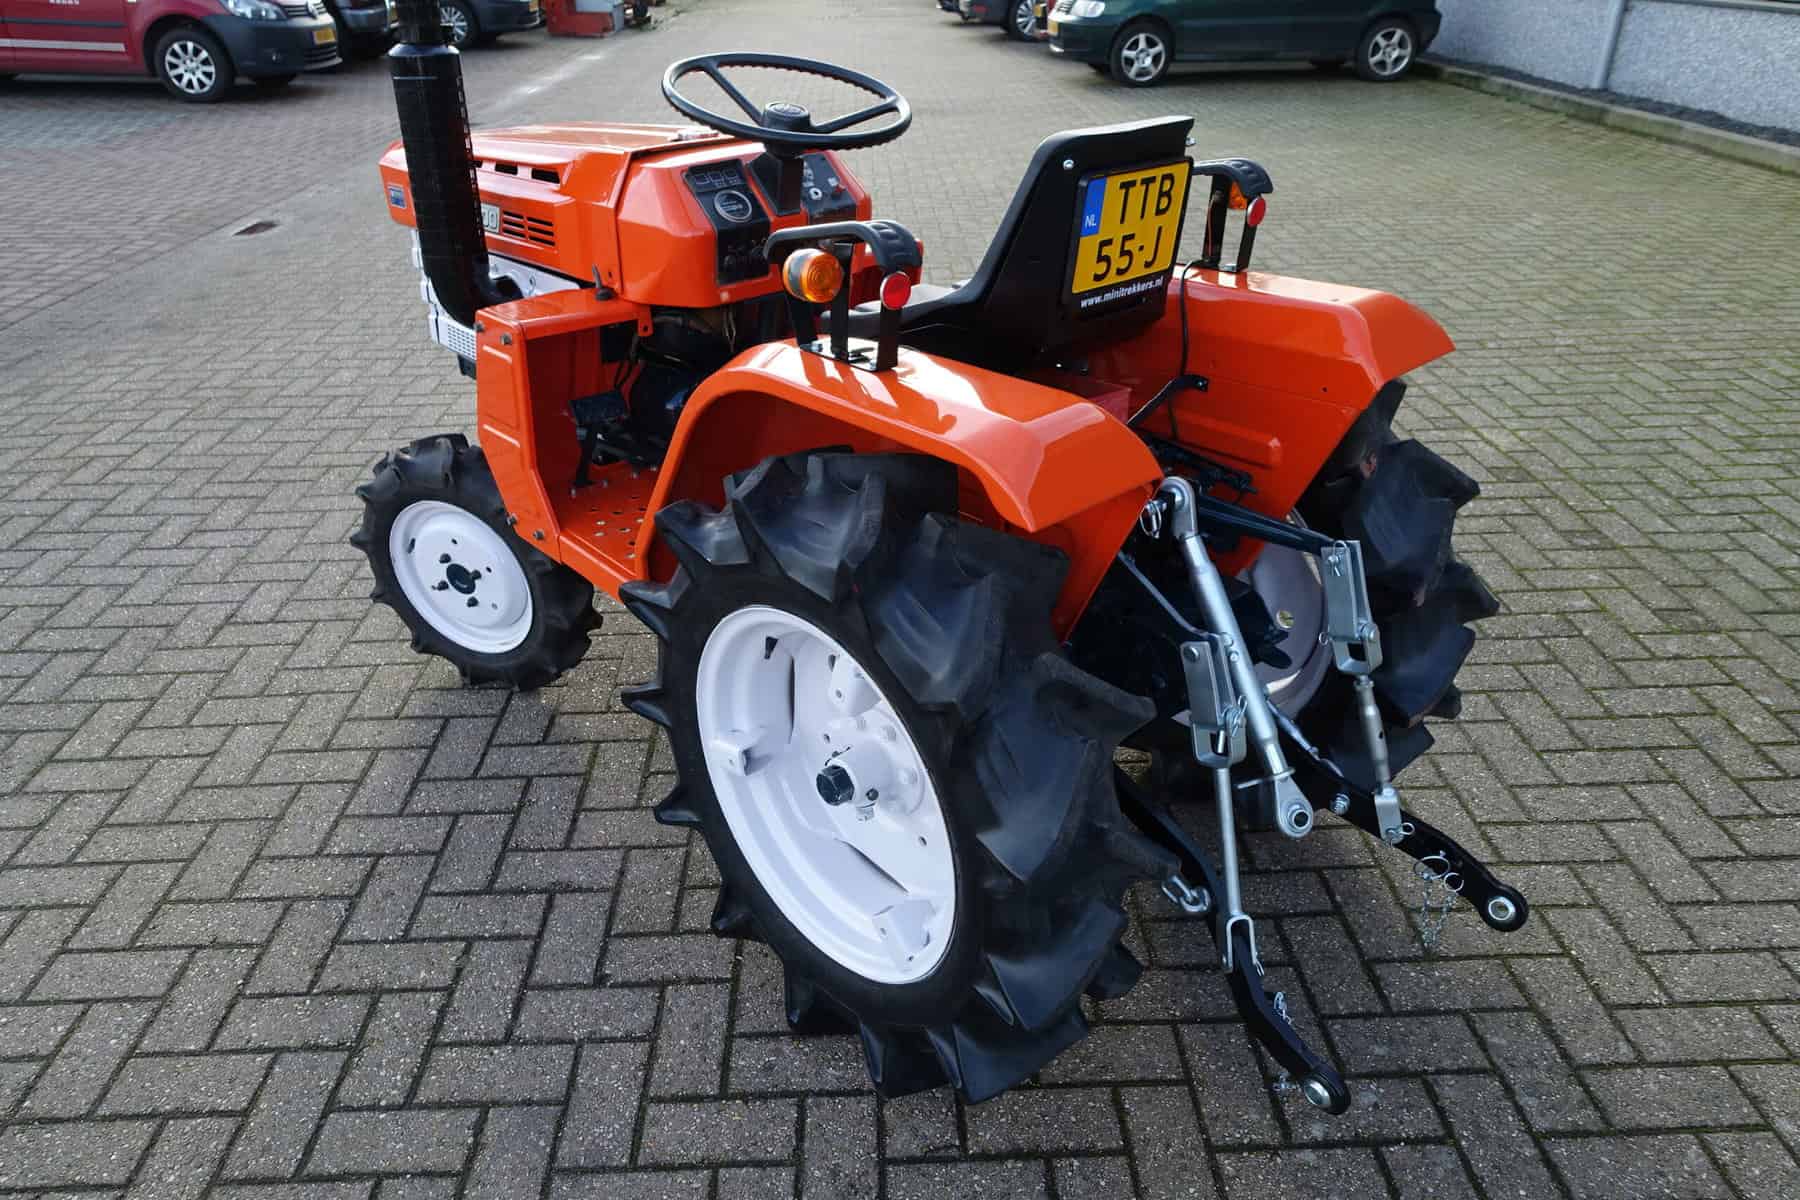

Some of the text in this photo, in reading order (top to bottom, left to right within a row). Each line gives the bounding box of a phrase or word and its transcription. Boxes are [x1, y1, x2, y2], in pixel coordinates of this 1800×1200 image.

[1119, 173, 1175, 225] TTB
[1085, 214, 1097, 228] NL
[1080, 276, 1164, 309] www.minitrekkers.nl
